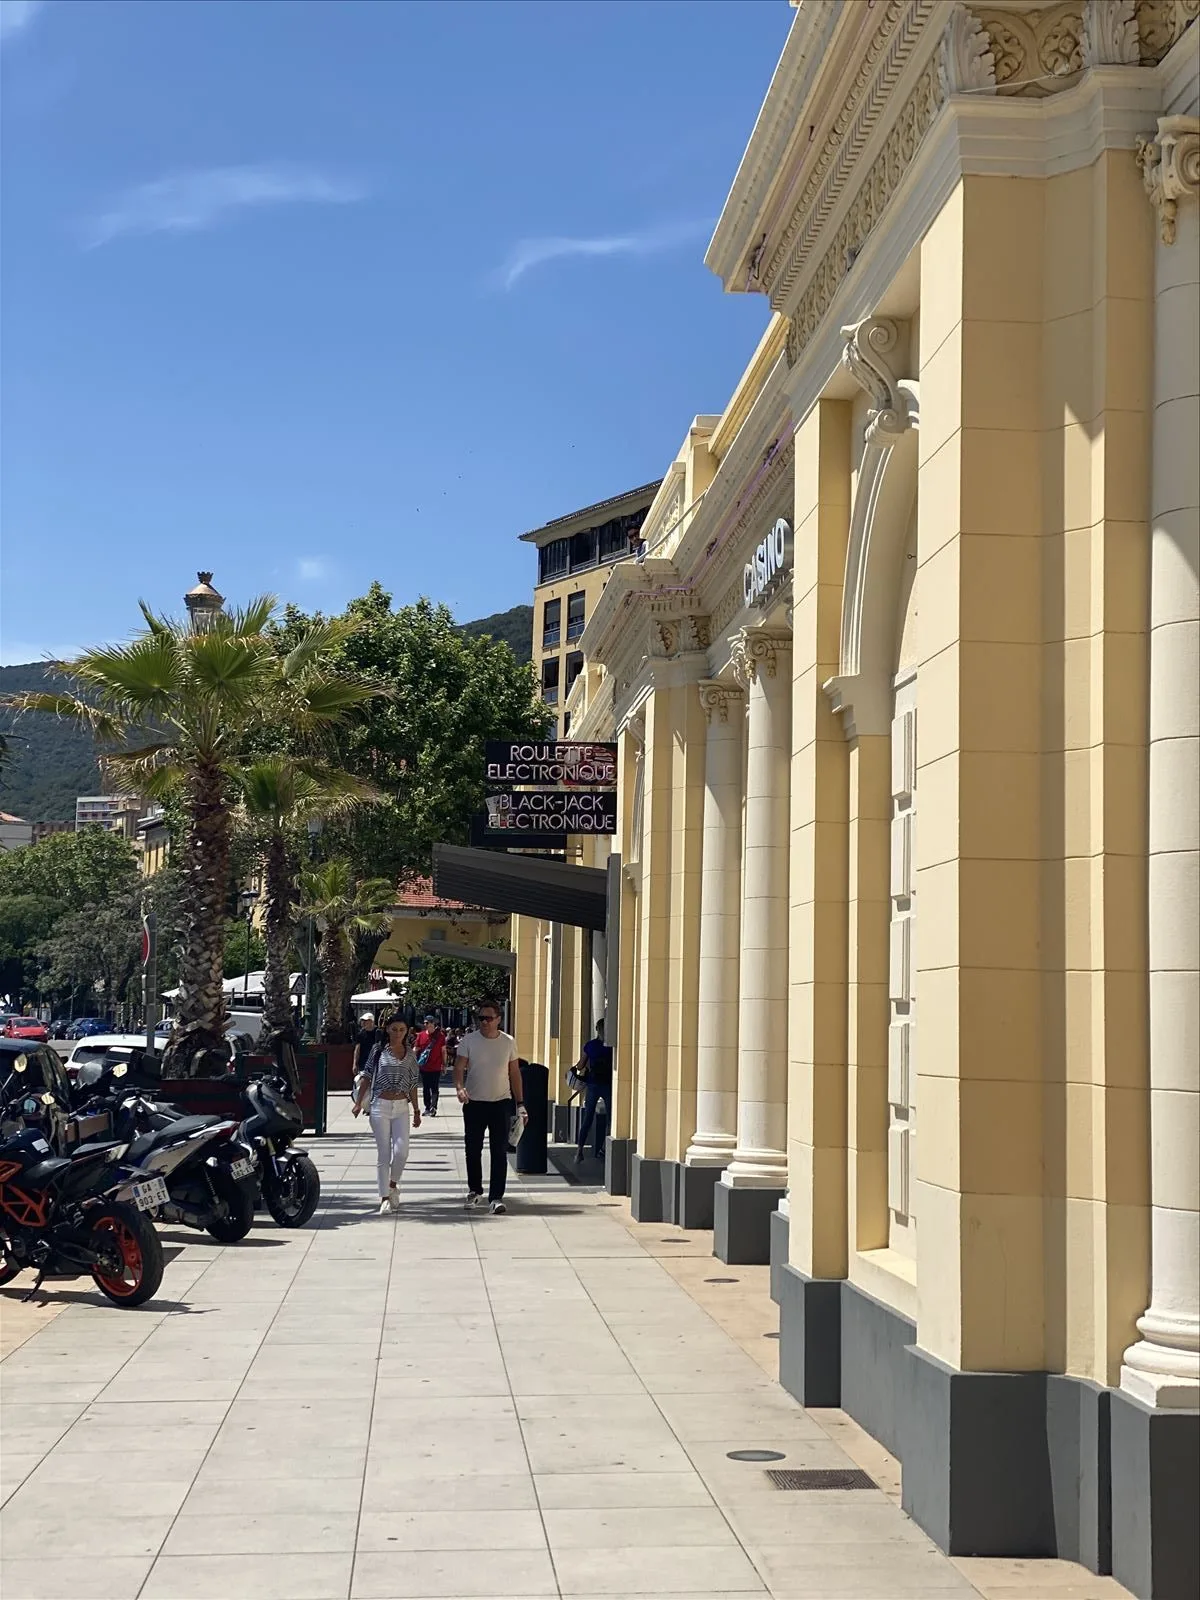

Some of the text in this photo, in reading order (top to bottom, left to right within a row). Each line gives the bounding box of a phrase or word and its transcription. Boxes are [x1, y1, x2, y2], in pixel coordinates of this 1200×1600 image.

[743, 517, 785, 609] CASINO
[510, 745, 593, 762] ROULETTE
[487, 763, 615, 781] ELECTRONIQUE
[499, 794, 604, 814] BLACK-JACK
[488, 813, 615, 830] ELECTRONIQUE
[141, 1183, 152, 1194] GA
